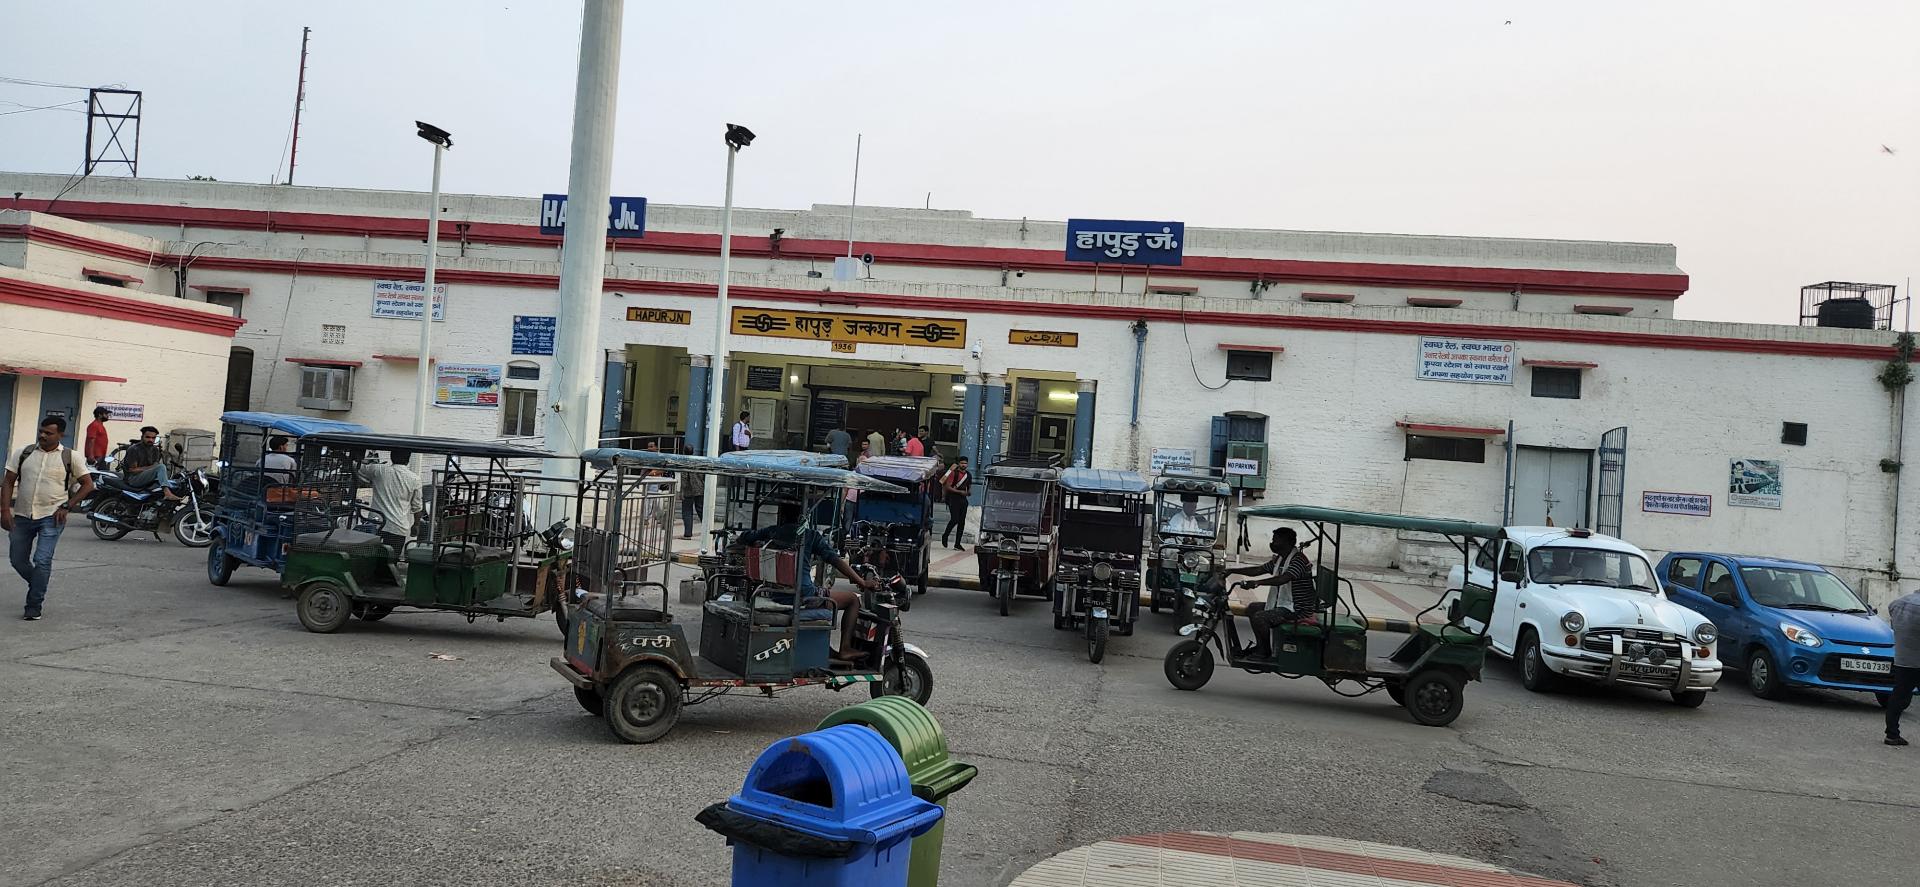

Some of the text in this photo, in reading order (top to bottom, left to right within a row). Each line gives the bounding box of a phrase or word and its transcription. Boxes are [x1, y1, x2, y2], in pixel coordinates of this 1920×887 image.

[1075, 230, 1142, 258] हापुड़
[795, 316, 834, 338] हापुड़
[834, 343, 852, 351] 1936
[1423, 340, 1443, 349] स्वच्छ
[1461, 343, 1481, 351] स्वच्छ
[1482, 344, 1503, 352] भारत
[1463, 361, 1473, 369] को
[1235, 462, 1256, 470] PARKING
[632, 635, 676, 648] परी
[753, 638, 794, 661] परी
